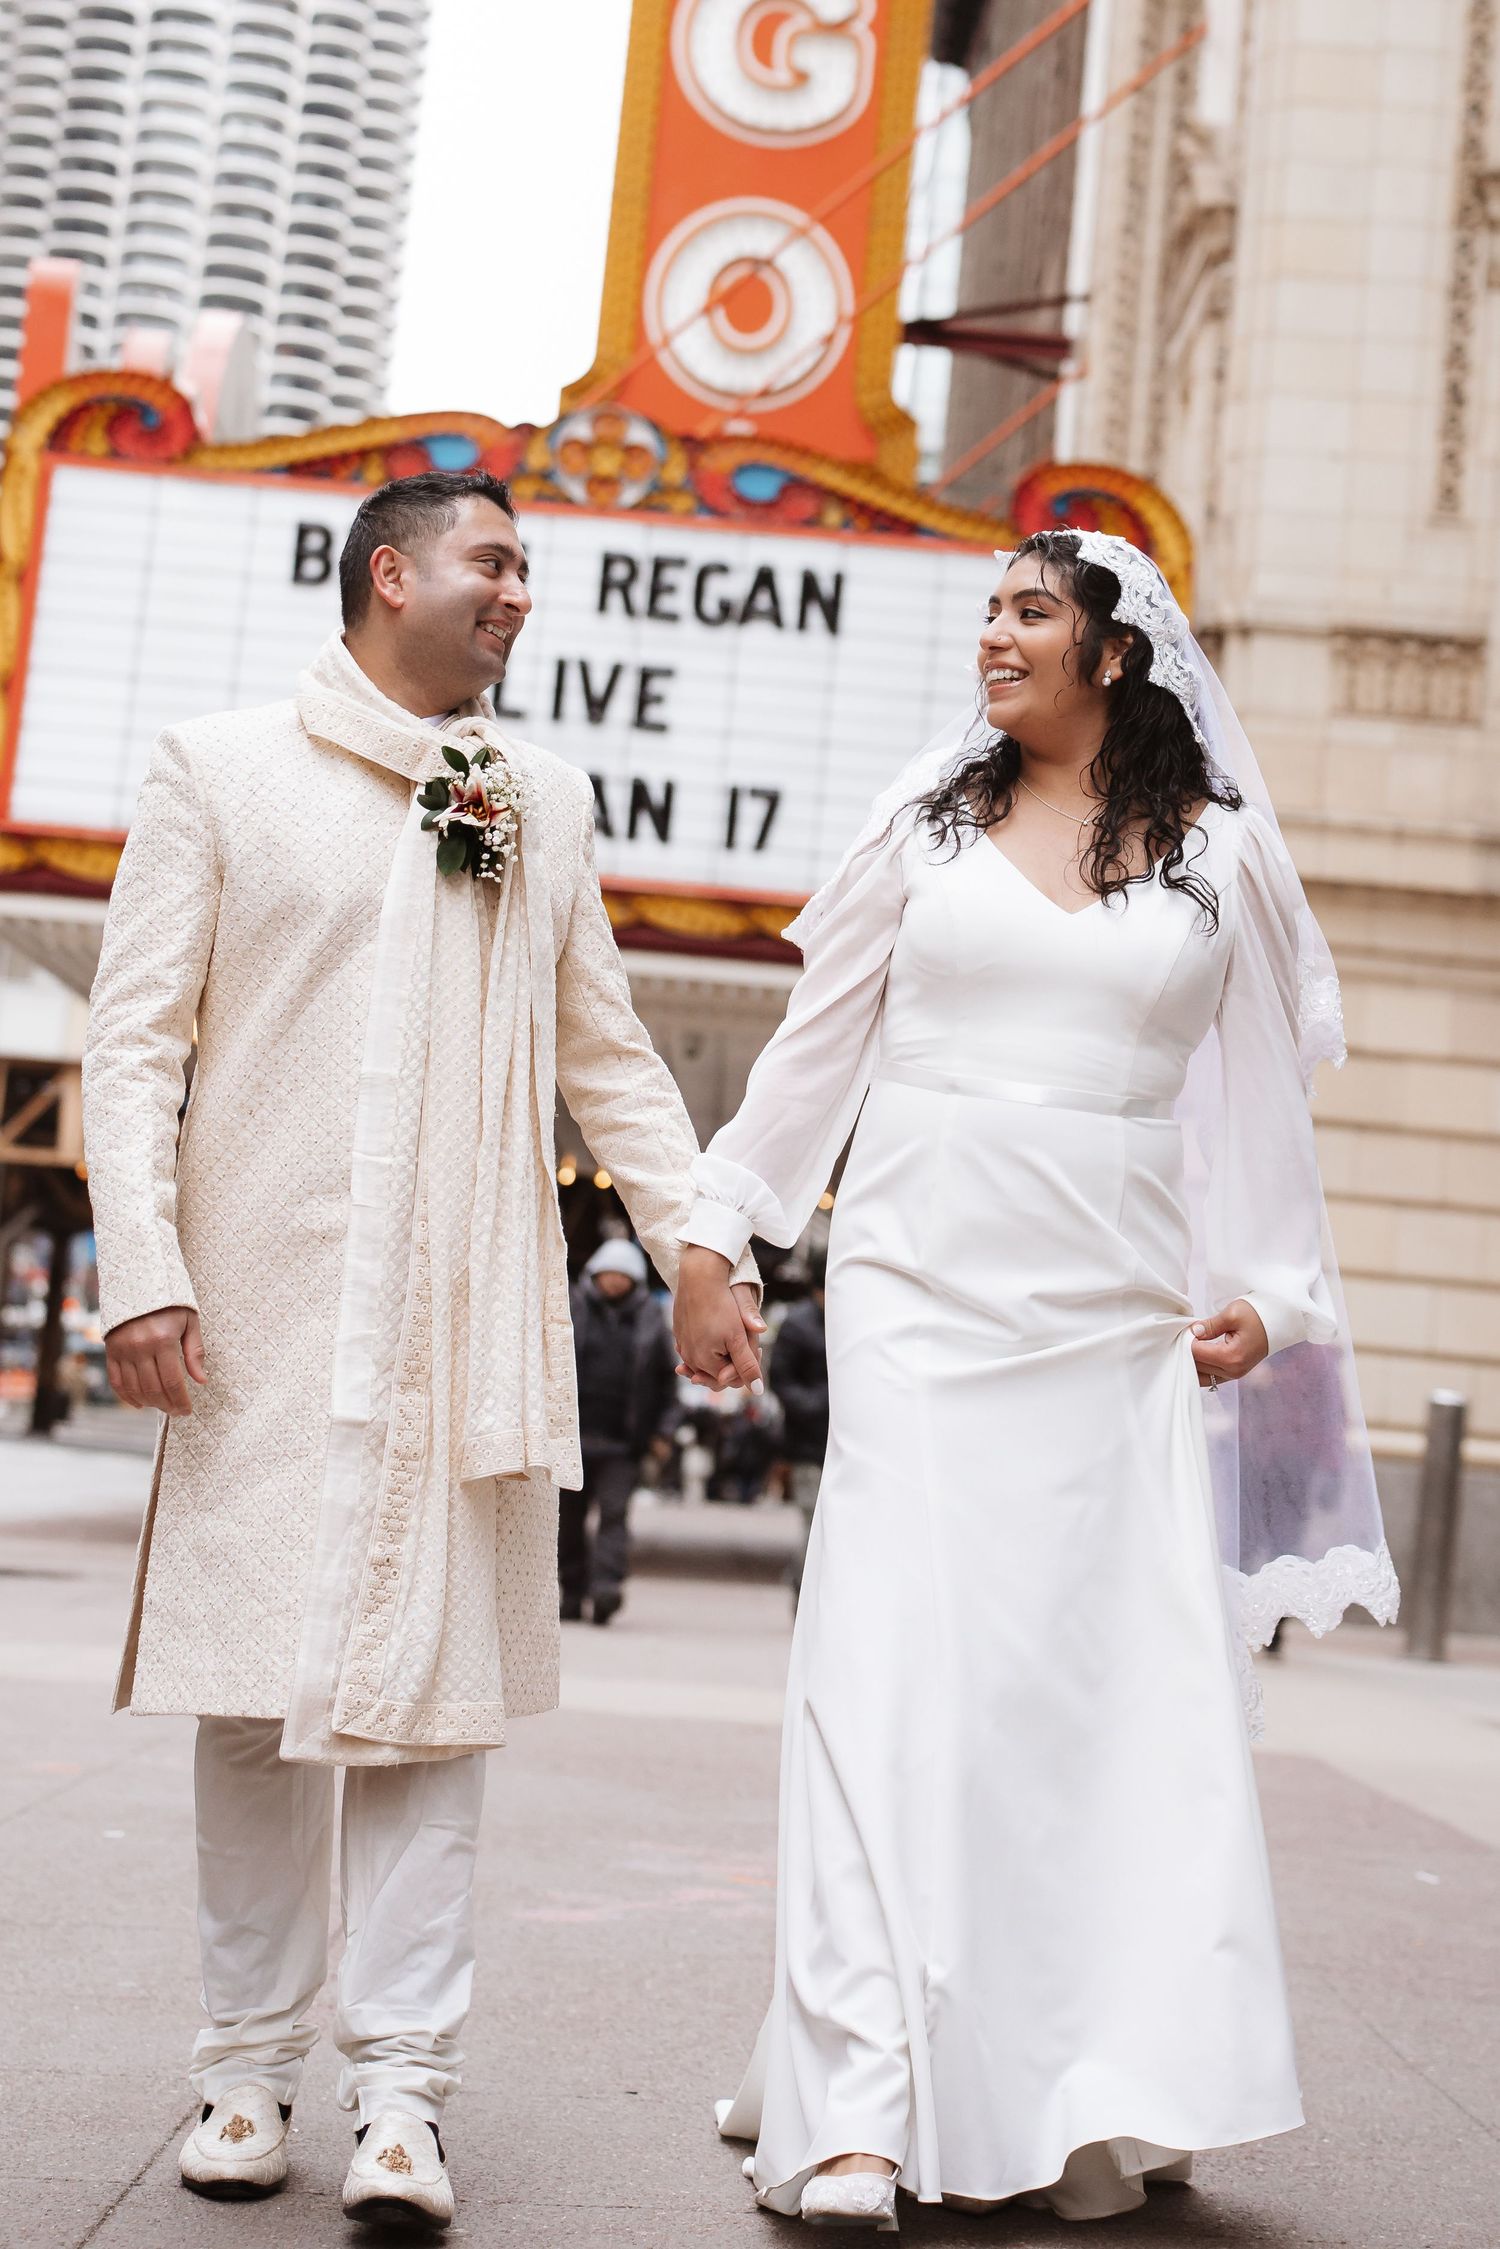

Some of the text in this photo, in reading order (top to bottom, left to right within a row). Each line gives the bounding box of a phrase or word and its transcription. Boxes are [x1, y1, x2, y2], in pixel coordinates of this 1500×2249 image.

[598, 552, 843, 635] REGAN
[494, 658, 674, 732] LIVE
[589, 772, 780, 849] AN 17
